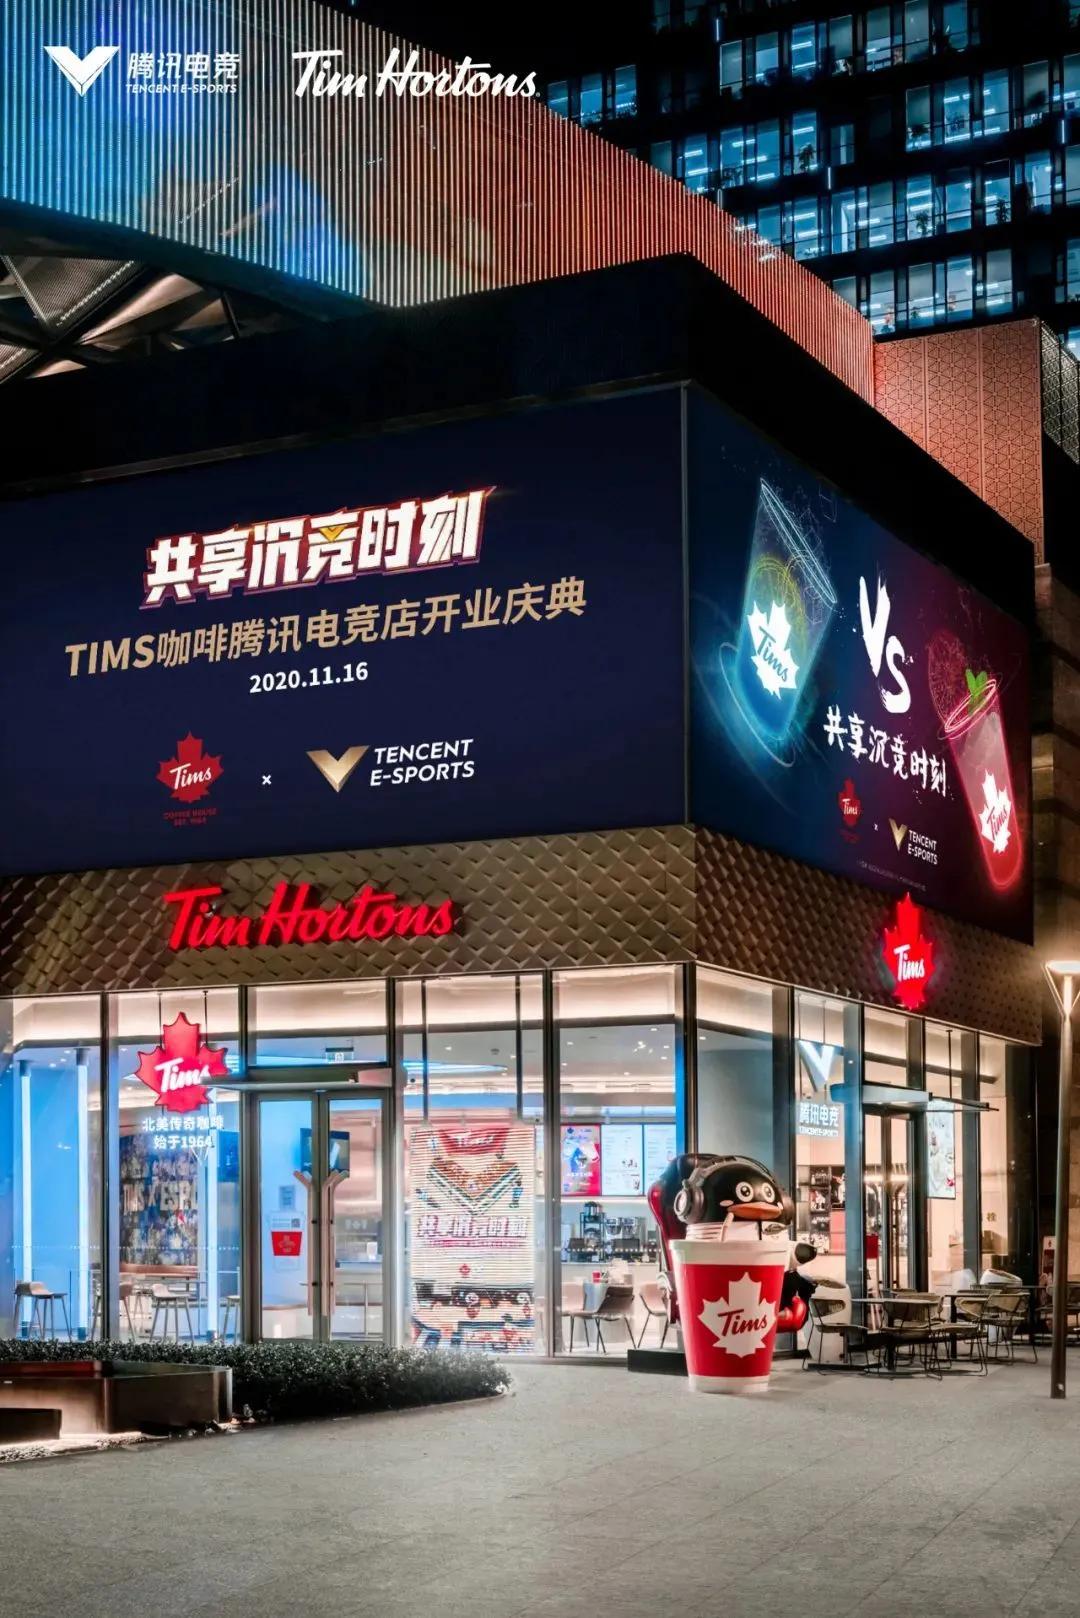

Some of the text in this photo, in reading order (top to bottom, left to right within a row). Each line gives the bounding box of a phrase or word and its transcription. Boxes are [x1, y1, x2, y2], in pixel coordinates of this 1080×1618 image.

[142, 489, 490, 606] 共享沉竞时刻
[759, 626, 789, 683] Tims
[248, 661, 369, 694] 2020.11.16
[374, 738, 475, 765] TENCENT
[823, 704, 947, 798] 共享沉竞时刻
[169, 762, 213, 791] Tims
[369, 760, 476, 787] E-SPORTS
[907, 843, 938, 865] E-SPORTS
[908, 830, 938, 851] TENCENT
[164, 880, 453, 949] Tim Hortons
[893, 944, 925, 982] Tims
[153, 1134, 213, 1150] 始于1964
[717, 1309, 768, 1337] Tims
